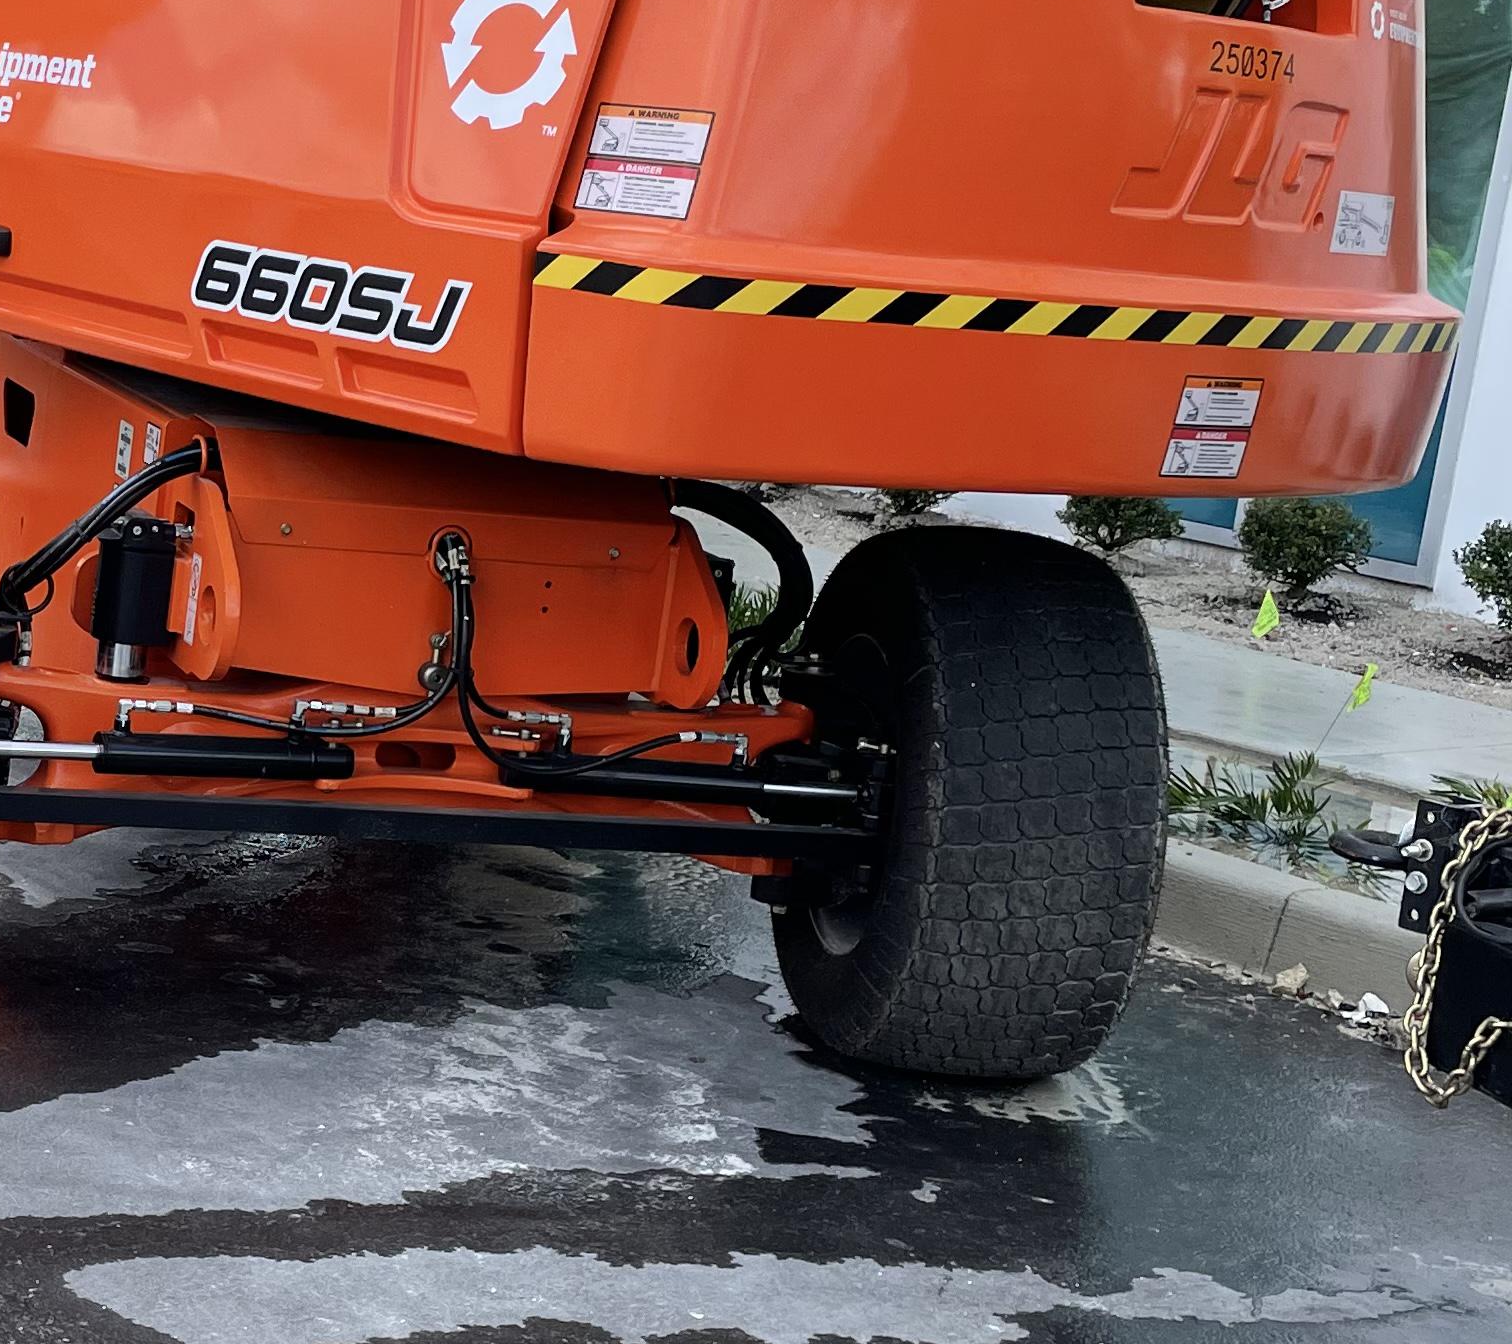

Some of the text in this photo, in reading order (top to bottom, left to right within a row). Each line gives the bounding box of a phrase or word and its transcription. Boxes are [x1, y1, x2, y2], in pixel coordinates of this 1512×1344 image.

[1209, 40, 1295, 83] 250374
[637, 109, 680, 120] WARNING
[541, 125, 558, 136] TM
[624, 163, 663, 175] DANGER
[192, 242, 469, 351] 660SJ
